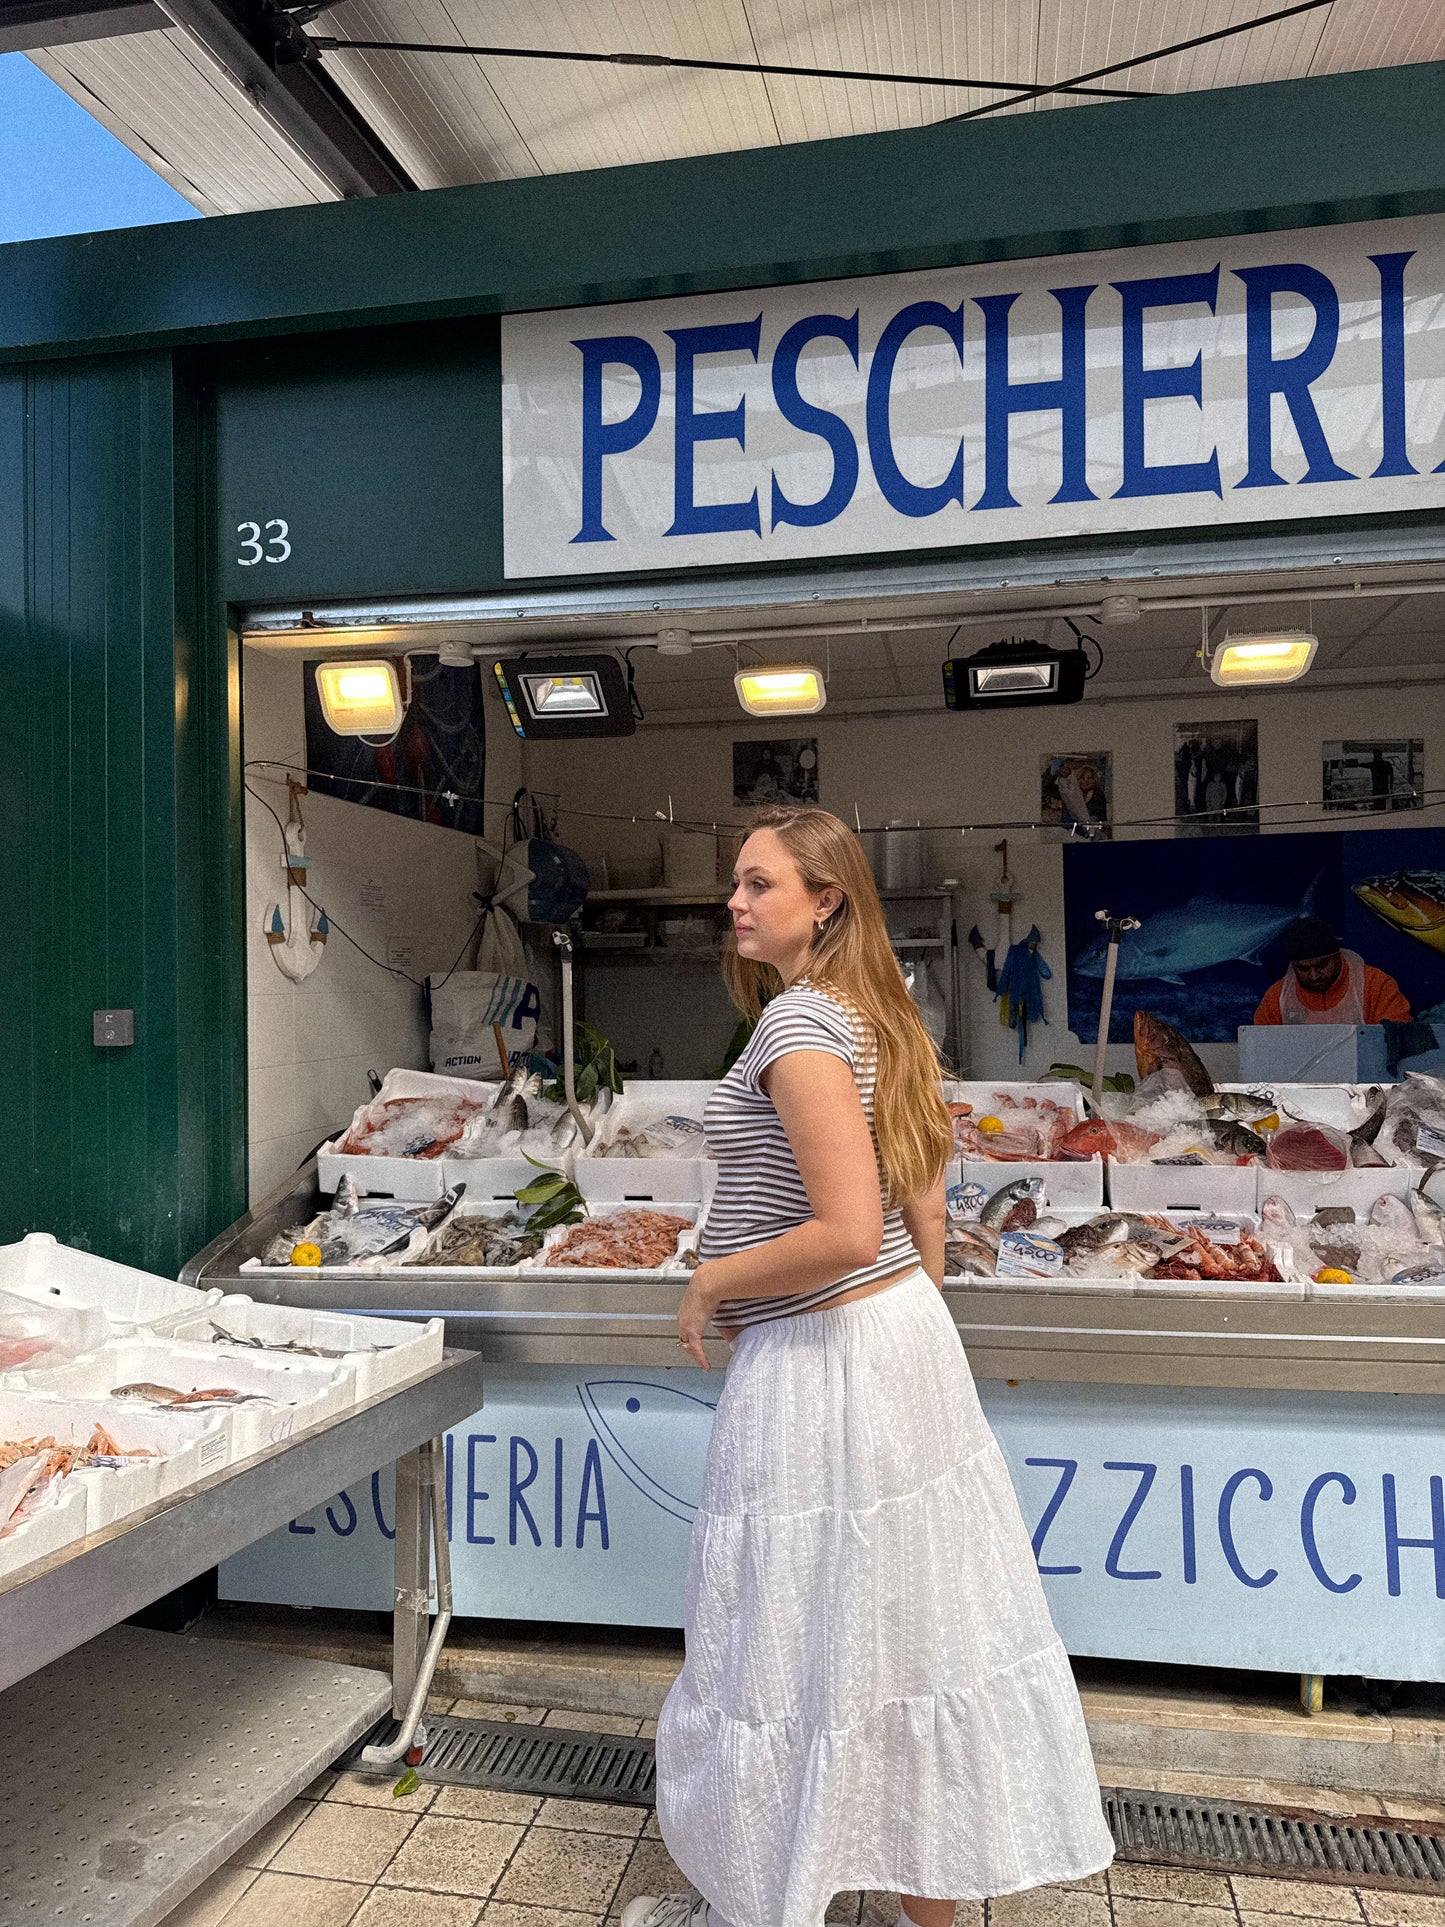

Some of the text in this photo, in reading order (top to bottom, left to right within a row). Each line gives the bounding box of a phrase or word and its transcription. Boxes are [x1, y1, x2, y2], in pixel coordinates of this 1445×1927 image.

[569, 250, 1445, 545] PESCHERI
[237, 518, 292, 566] 33
[445, 1055, 481, 1067] ACTION
